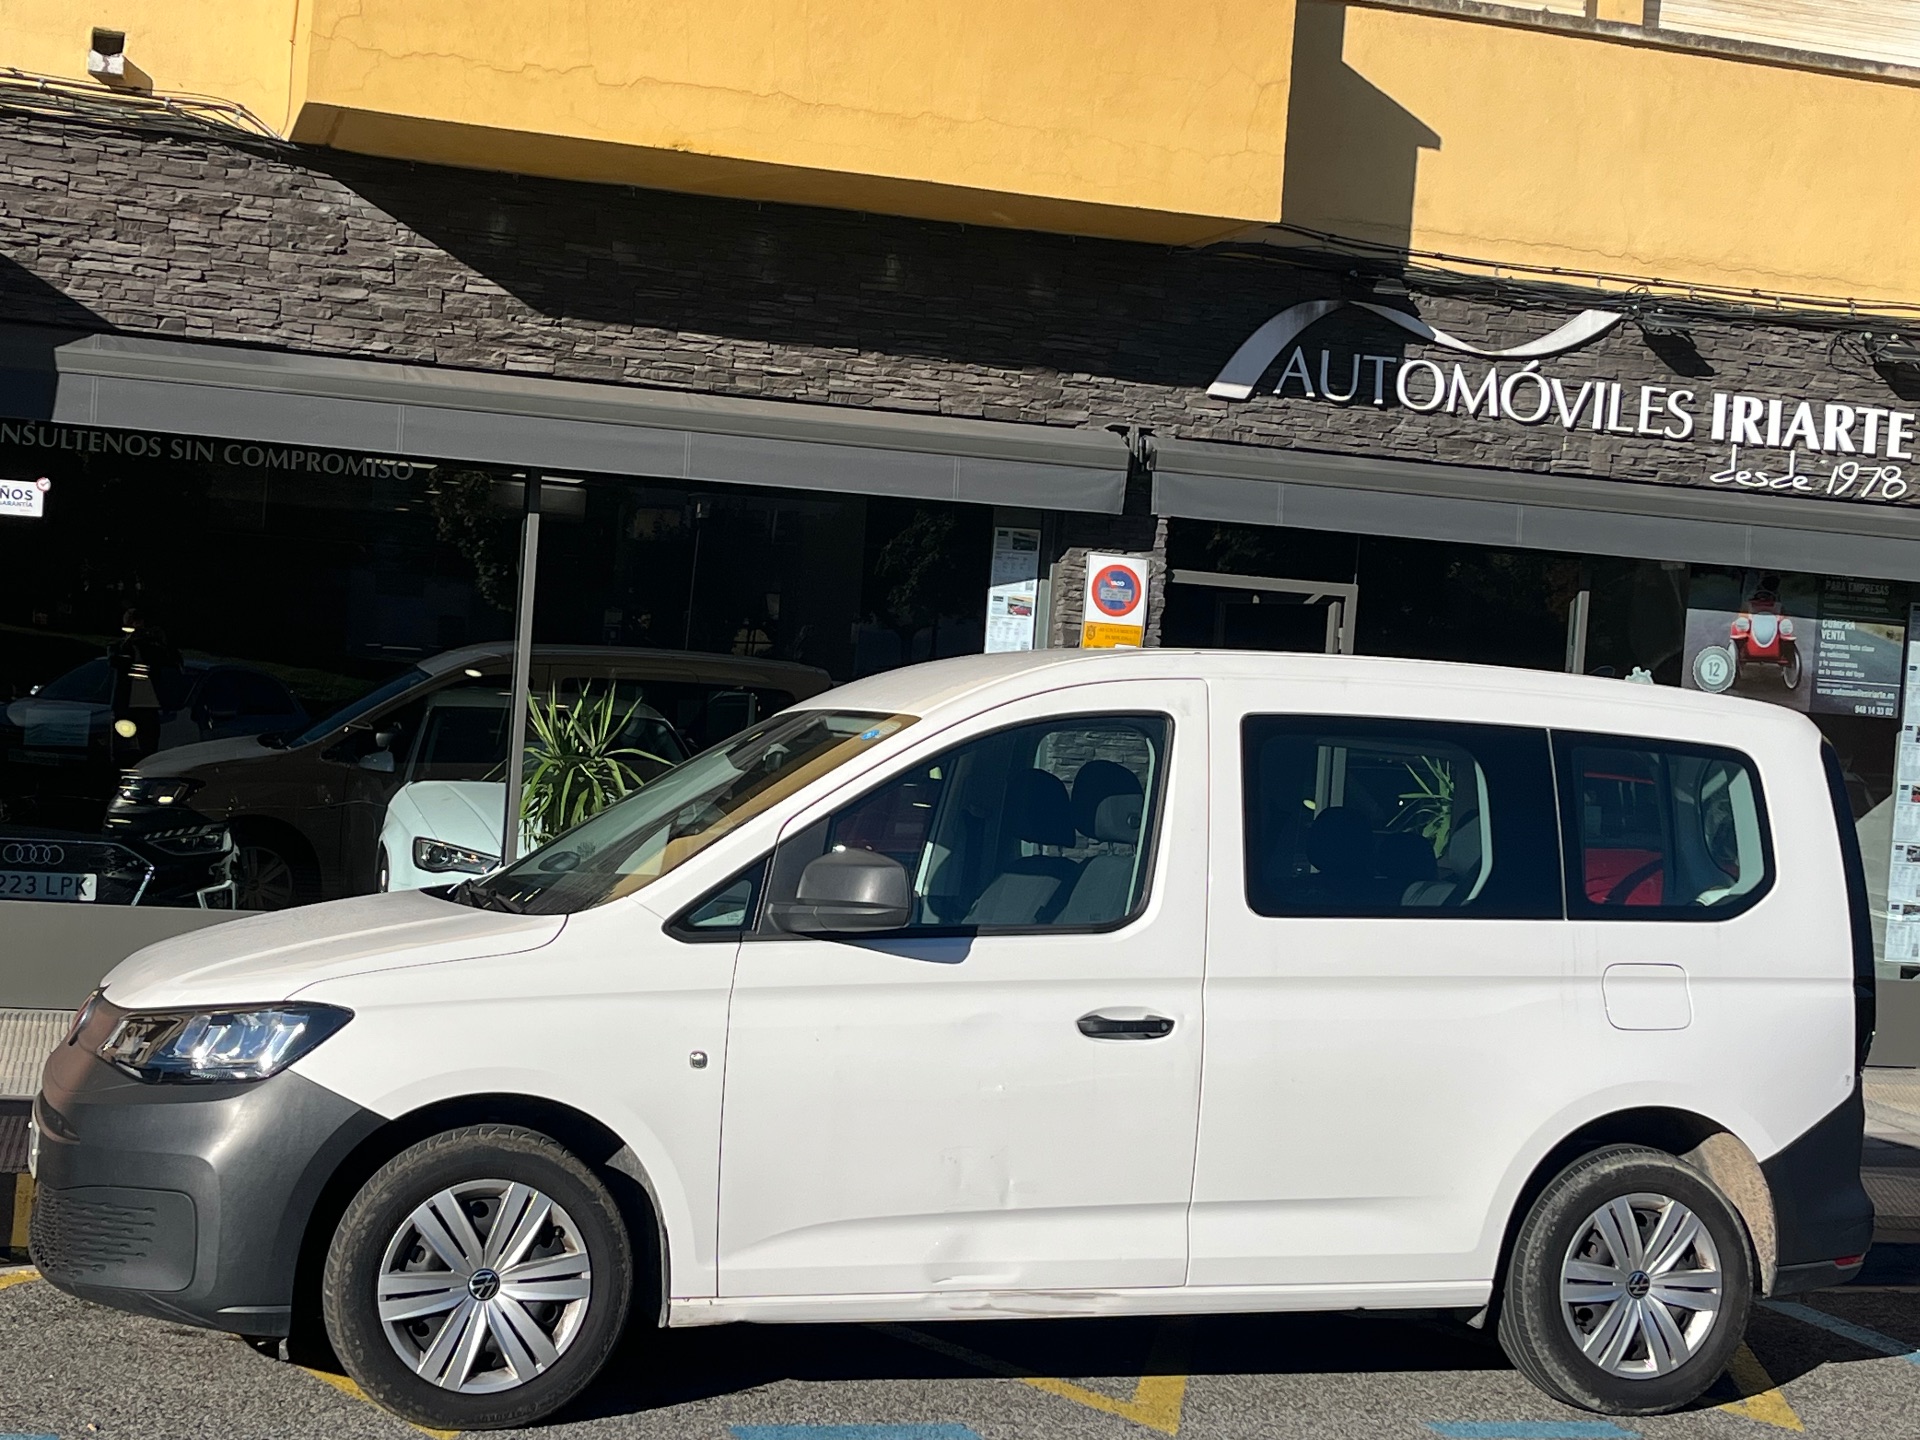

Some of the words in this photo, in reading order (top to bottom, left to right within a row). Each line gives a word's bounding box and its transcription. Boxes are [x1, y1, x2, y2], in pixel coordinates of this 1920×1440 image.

[1273, 345, 1695, 440] AUTOMÓVILES
[1711, 392, 1915, 460] IRIARTE
[170, 438, 214, 463] SIN
[224, 444, 413, 480] COMPROMISO
[1711, 445, 1811, 492] desde
[1826, 463, 1907, 500] 1978
[0, 500, 33, 508] ARANTÍA
[1820, 629, 1846, 641] VENTA
[1708, 662, 1720, 677] 12
[46, 876, 88, 896] LPK
